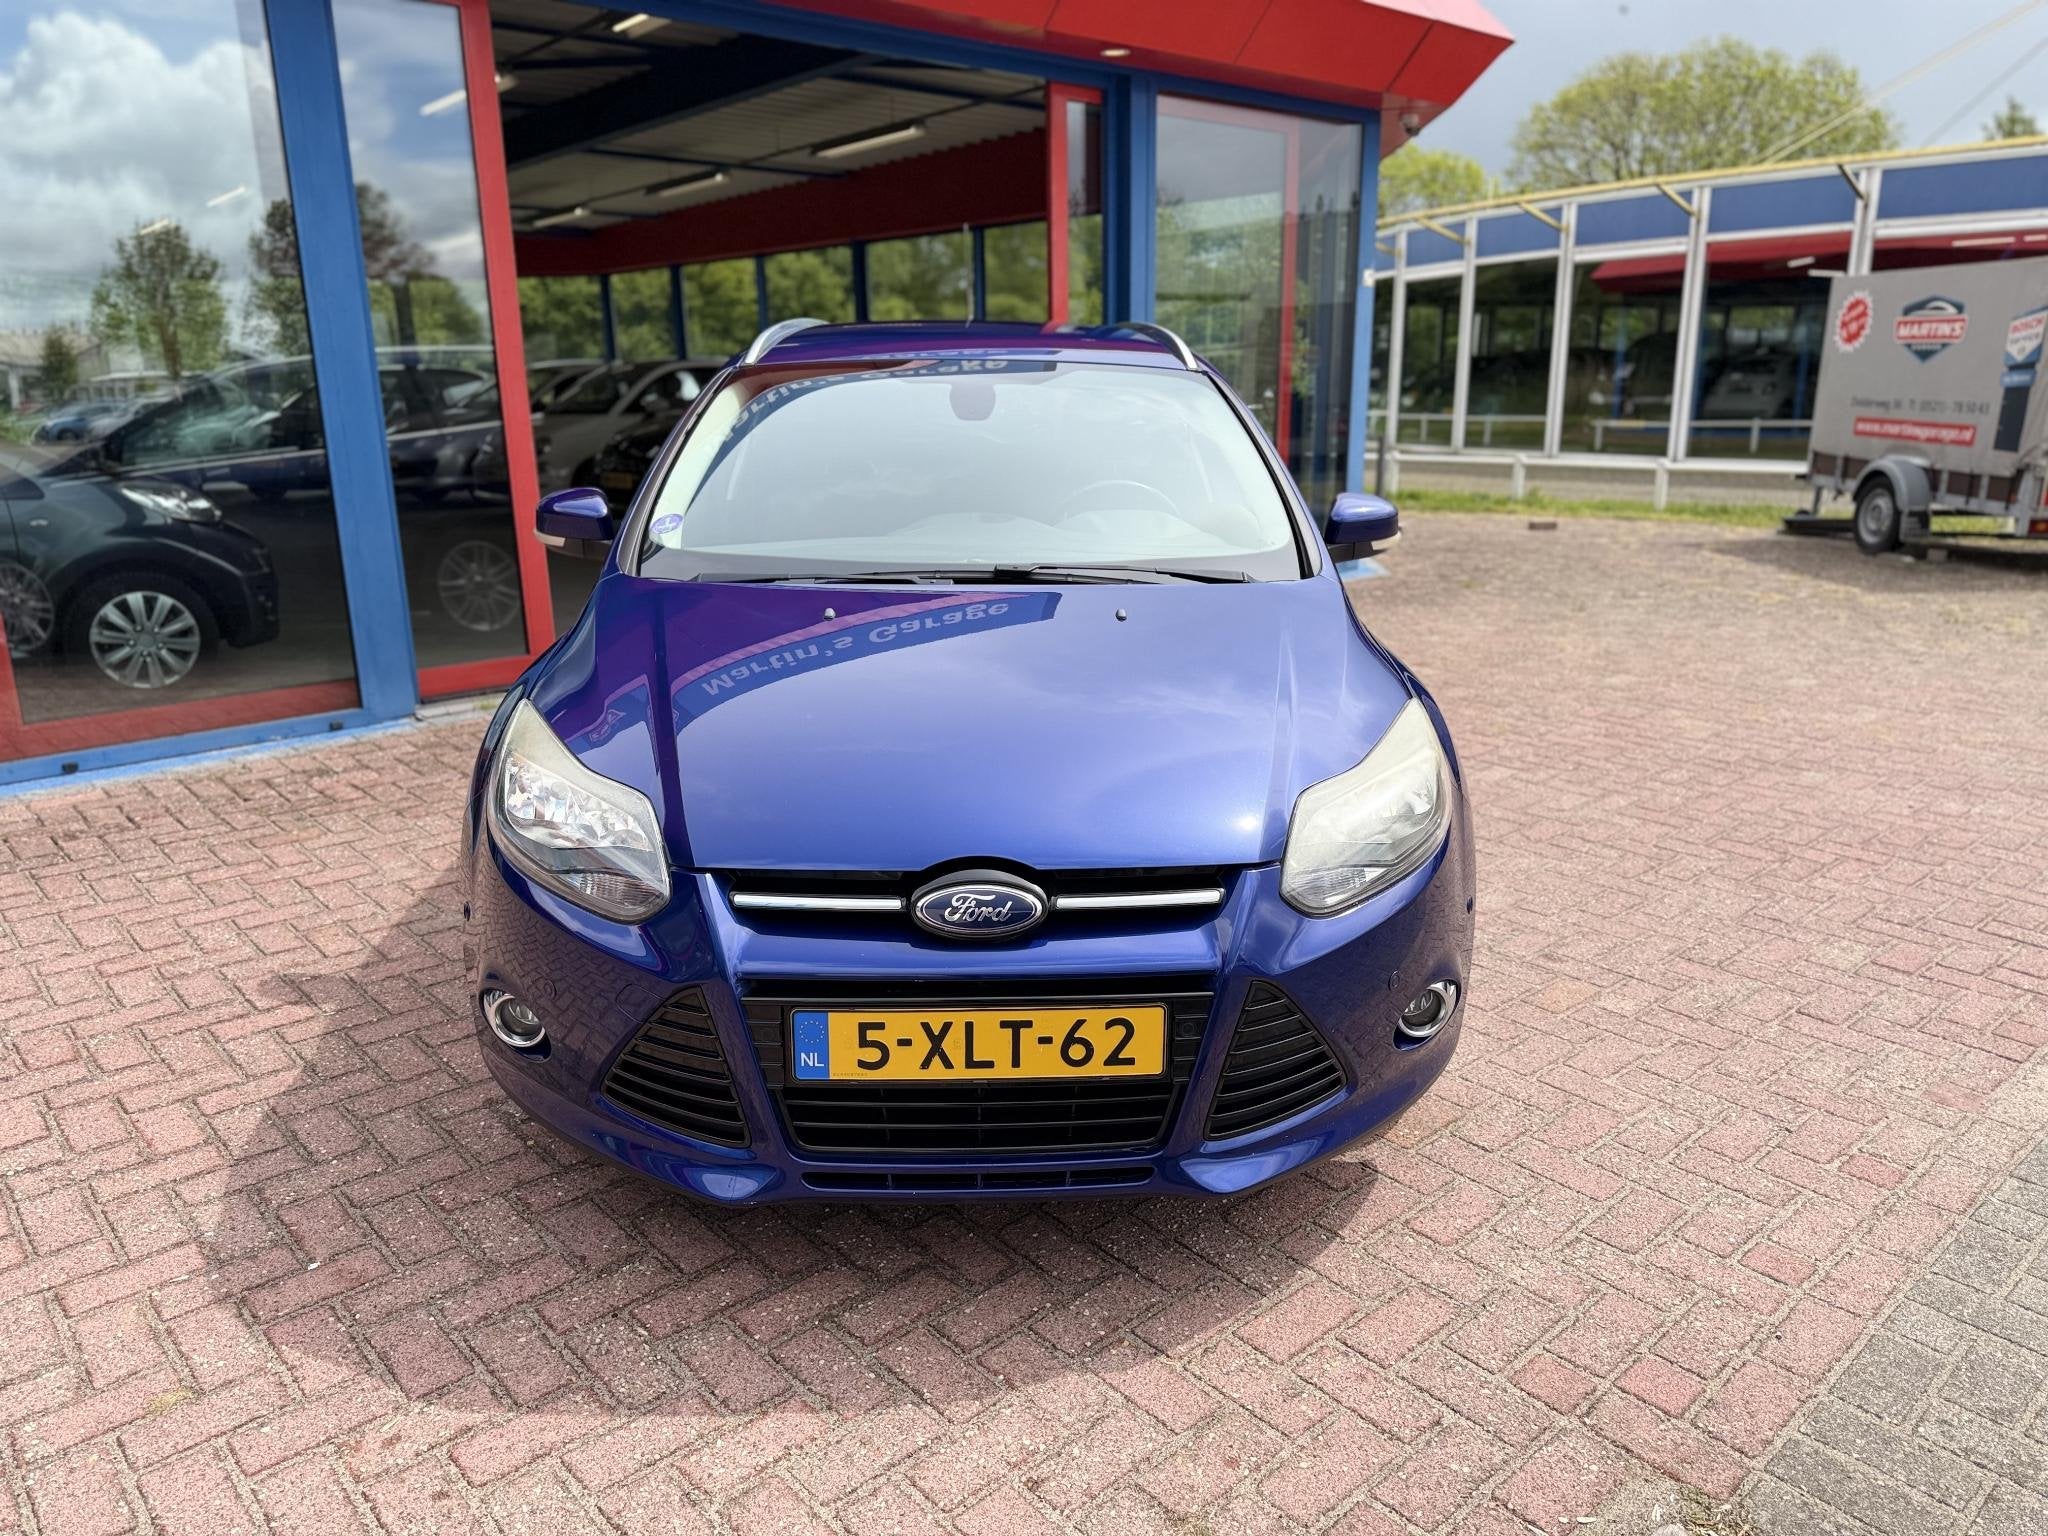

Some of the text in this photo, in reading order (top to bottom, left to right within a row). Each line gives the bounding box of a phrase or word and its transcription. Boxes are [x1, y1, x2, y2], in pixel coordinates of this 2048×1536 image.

[944, 893, 1014, 923] Ford
[801, 1017, 1136, 1070] NL 5-XLT-62
